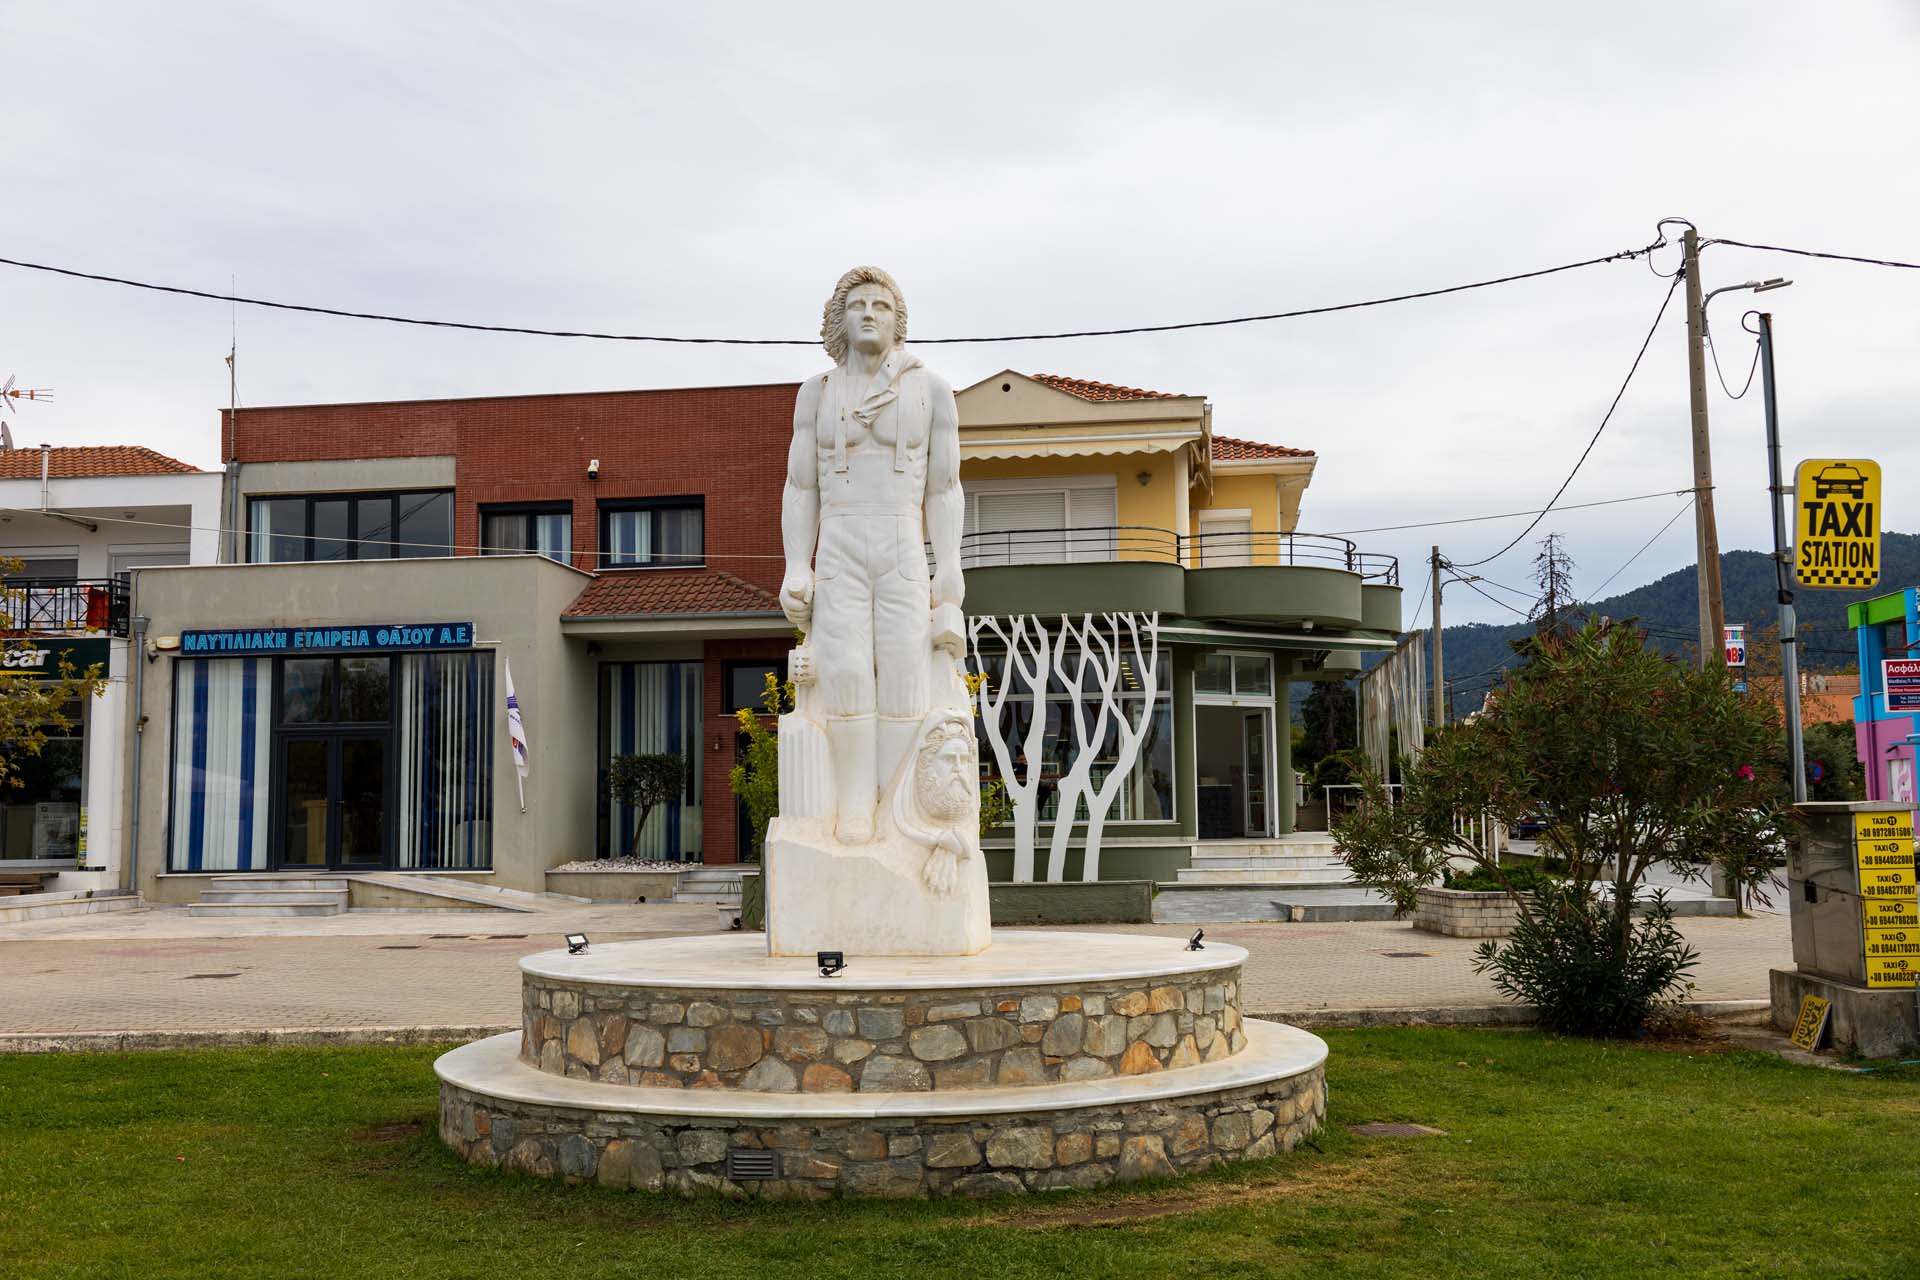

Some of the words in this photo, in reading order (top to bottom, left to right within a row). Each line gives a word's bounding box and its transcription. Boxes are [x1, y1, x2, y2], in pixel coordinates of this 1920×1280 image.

[1804, 502, 1873, 537] TAXI
[1801, 541, 1874, 568] STATION
[184, 631, 287, 650] ΝΑΥΤΙΛΙΑΚΗ
[294, 629, 370, 648] ΕΤΑΙΡΕΙΑ
[376, 627, 434, 645] ΘΑΣΟΥ
[440, 626, 470, 643] Α.Ε.
[1872, 817, 1886, 825] TAXI
[1796, 1000, 1815, 1043] STATION
[1802, 1003, 1825, 1046] TAXI
